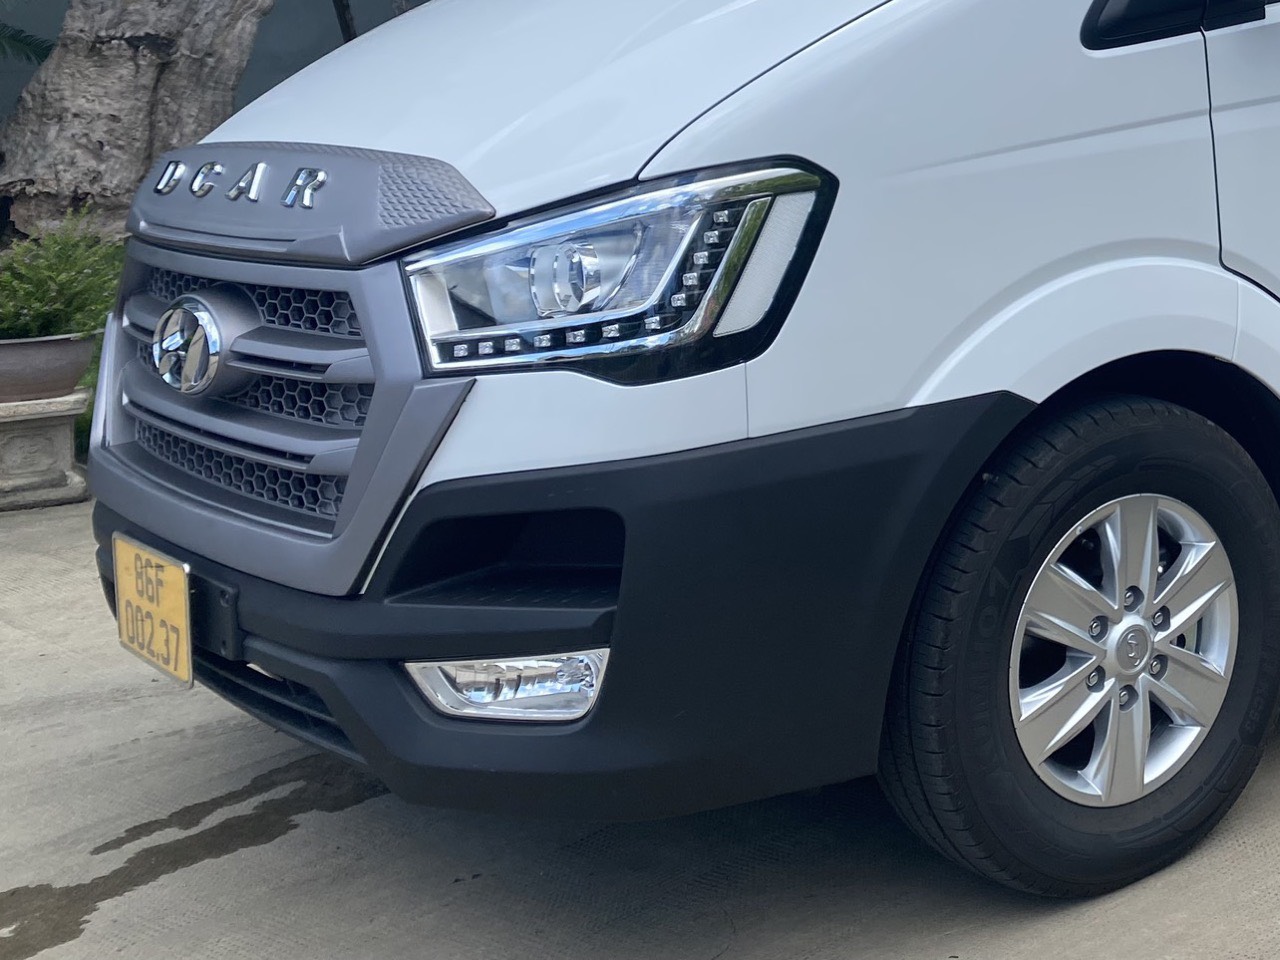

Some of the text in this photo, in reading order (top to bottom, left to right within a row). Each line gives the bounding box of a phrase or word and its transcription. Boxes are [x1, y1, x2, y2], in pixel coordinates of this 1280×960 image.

[153, 160, 329, 209] DCAR
[134, 553, 165, 607] 86F
[125, 599, 180, 672] 002.37
